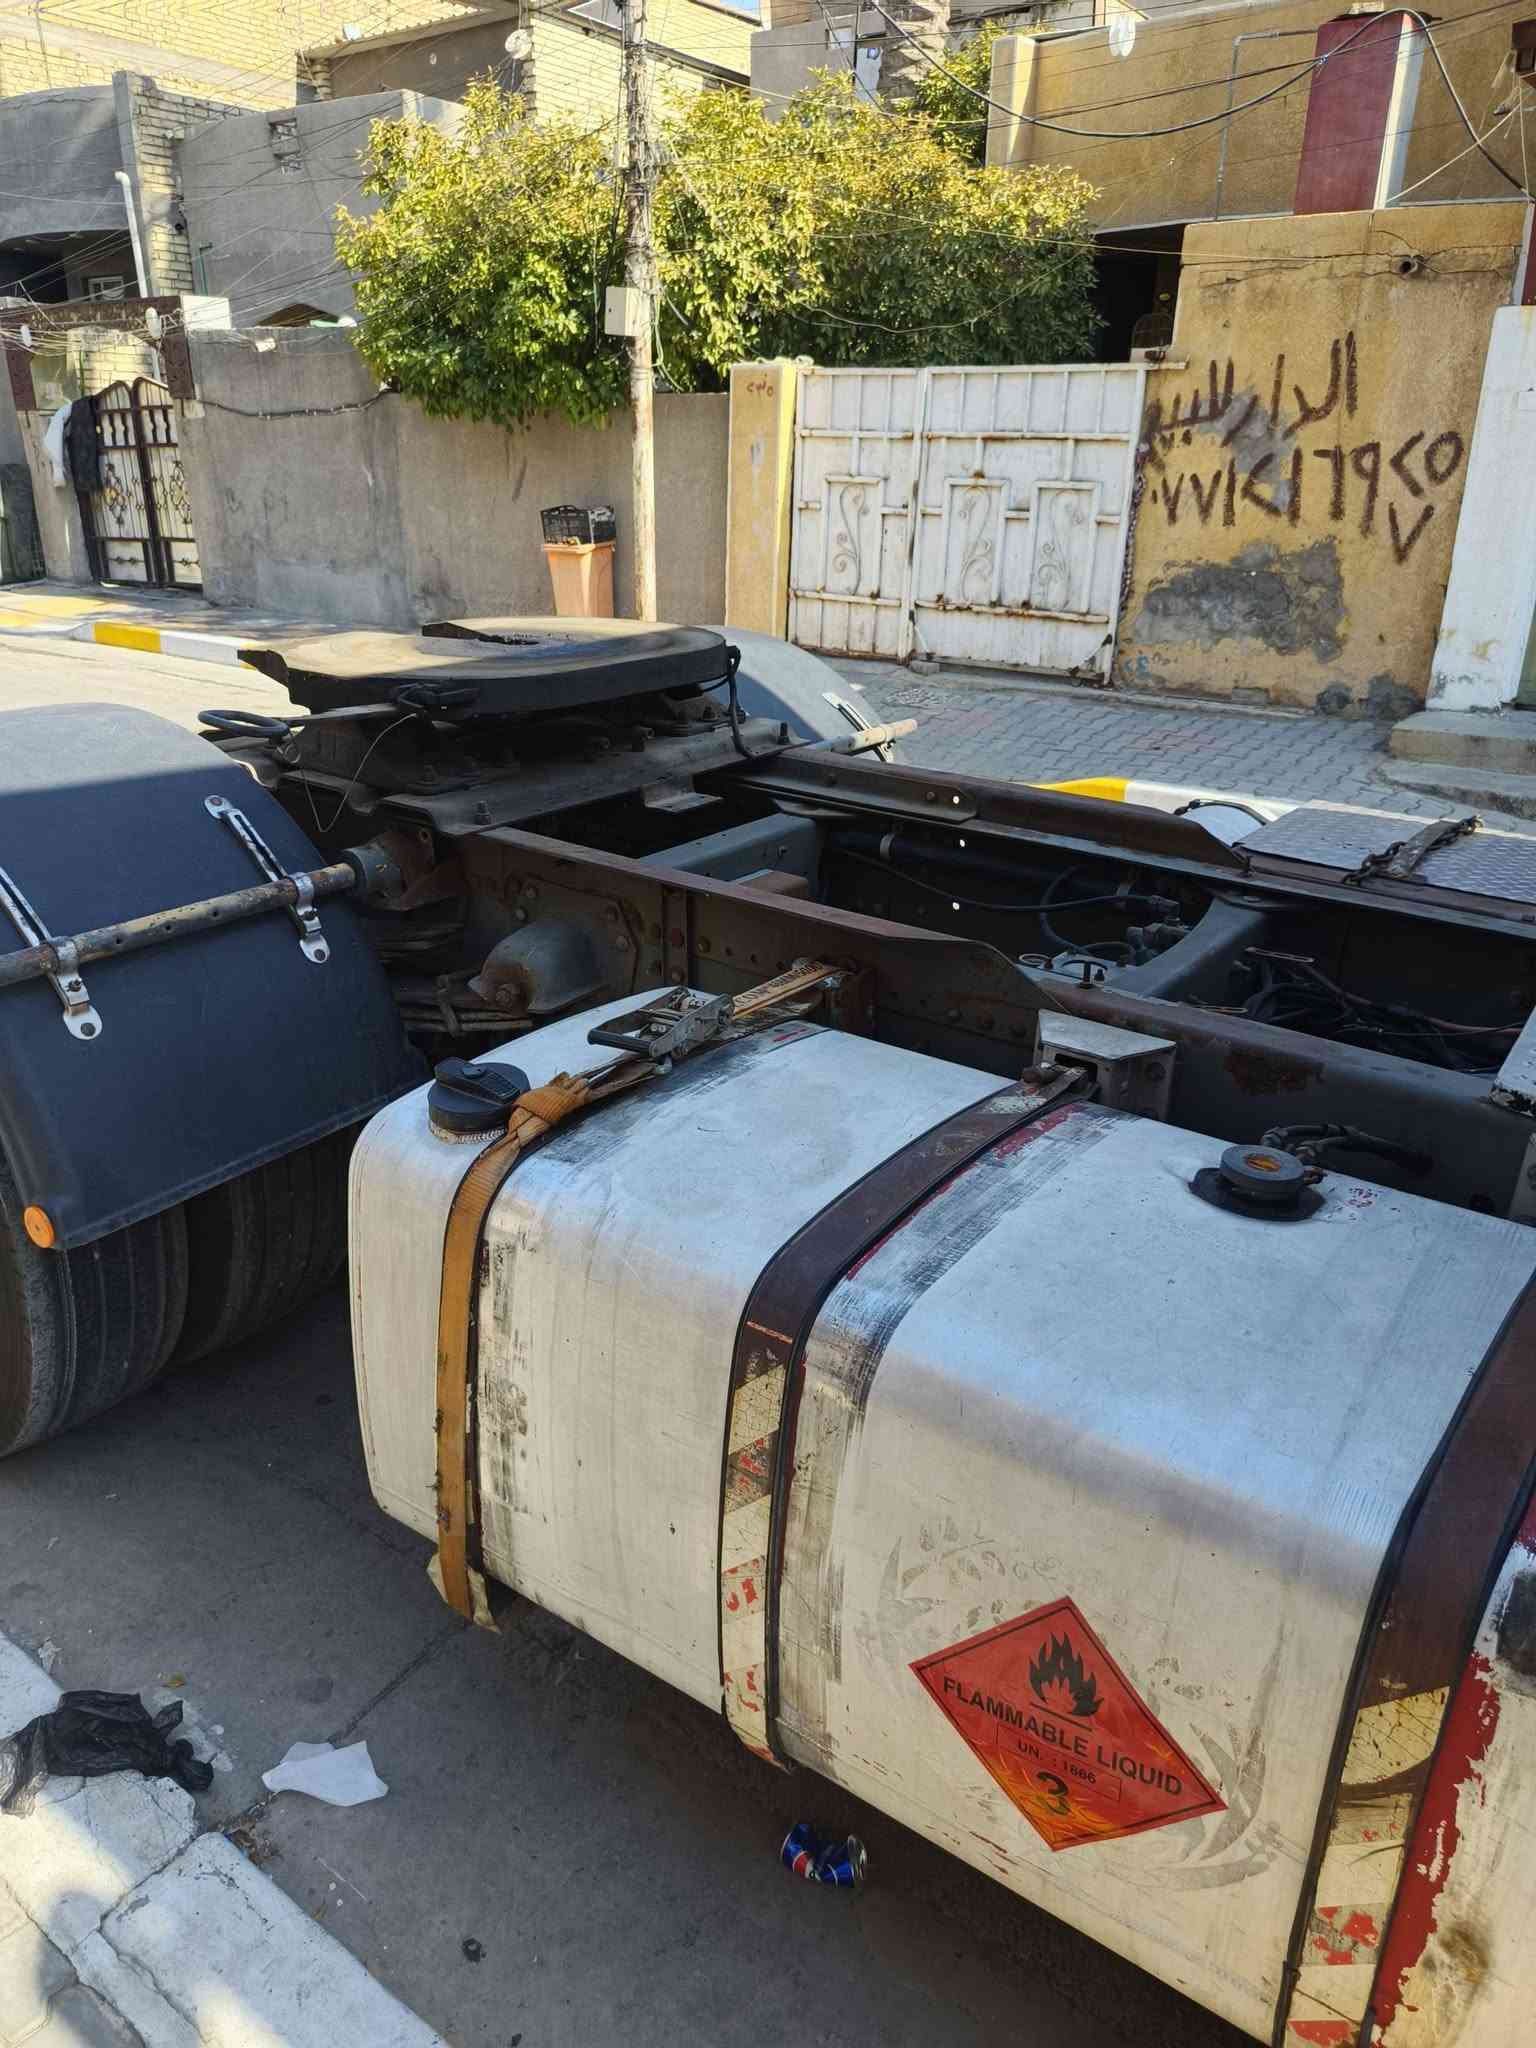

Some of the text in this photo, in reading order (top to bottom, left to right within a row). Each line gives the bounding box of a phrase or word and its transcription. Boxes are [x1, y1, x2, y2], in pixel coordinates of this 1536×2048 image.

[1221, 331, 1359, 447] الدار
[943, 1676, 1183, 1796] FLAMMABLE LIQUID
[1036, 1771, 1071, 1816] 3
